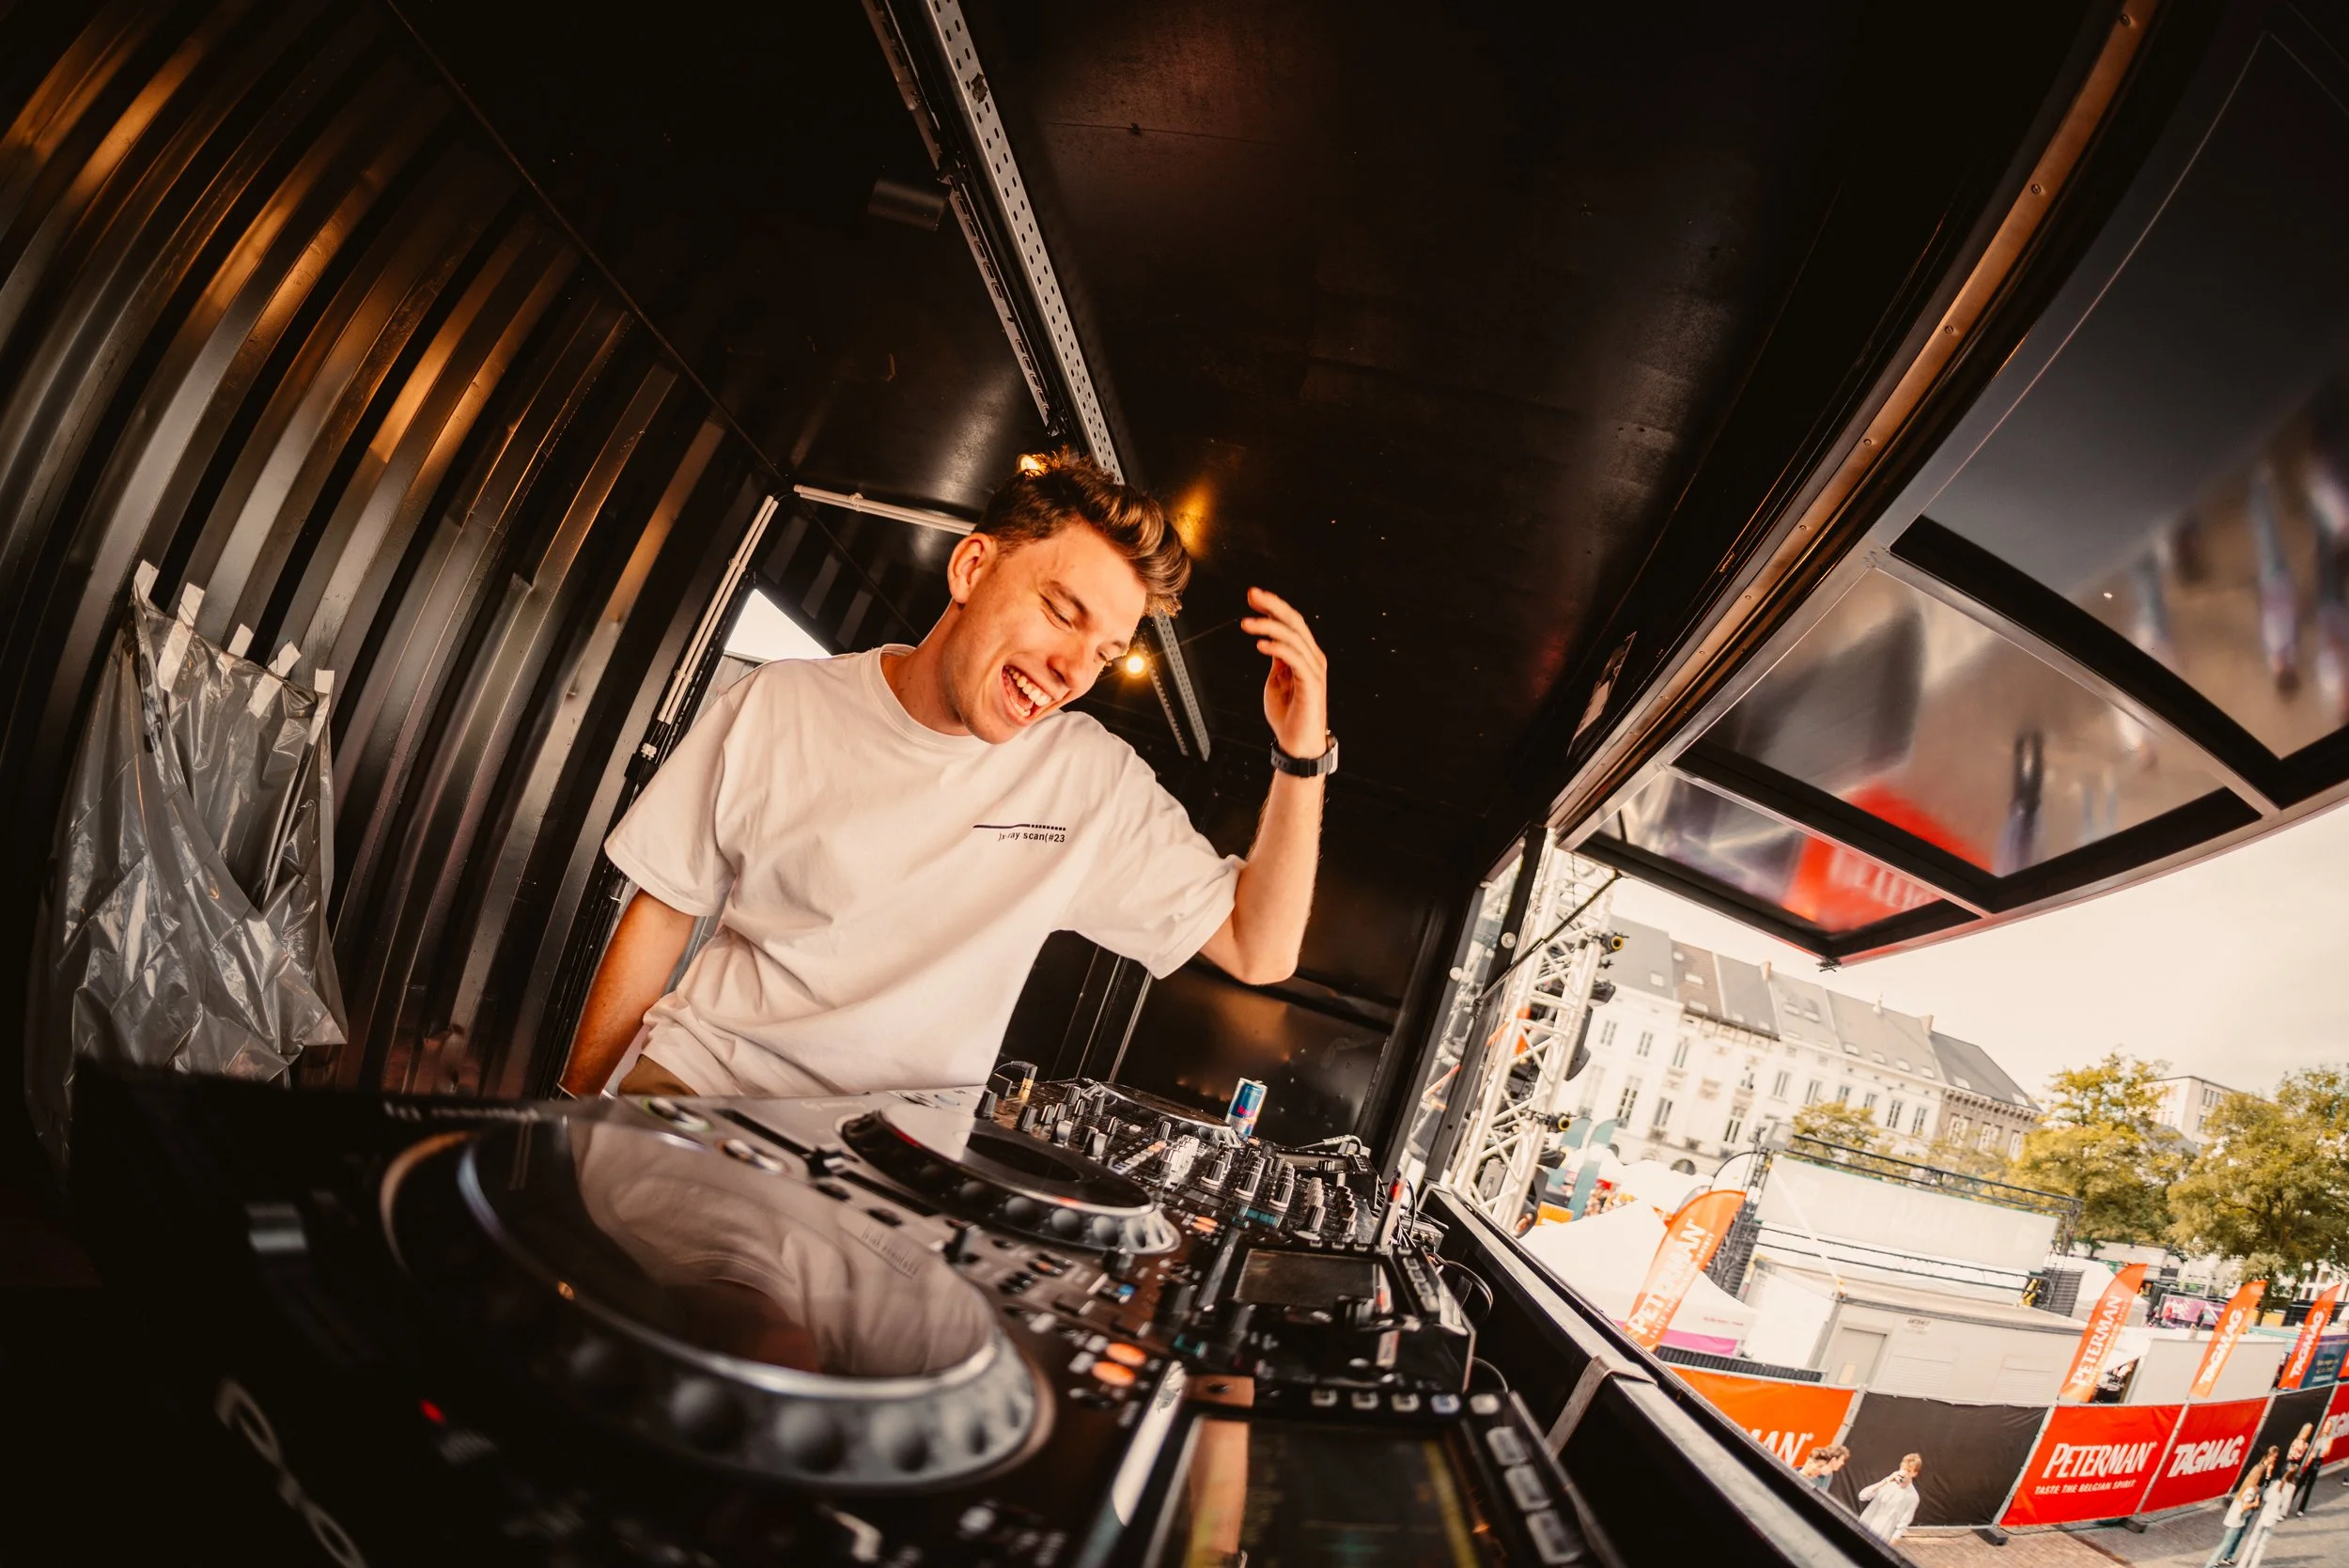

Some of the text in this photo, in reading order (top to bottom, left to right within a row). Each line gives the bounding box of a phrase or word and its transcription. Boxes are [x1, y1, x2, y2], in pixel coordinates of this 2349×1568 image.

[2070, 1295, 2123, 1387] PETERMAN
[2042, 1441, 2155, 1479] PETERMAN
[2034, 1479, 2137, 1495] TASTE THE BELGIAN SPIRIT
